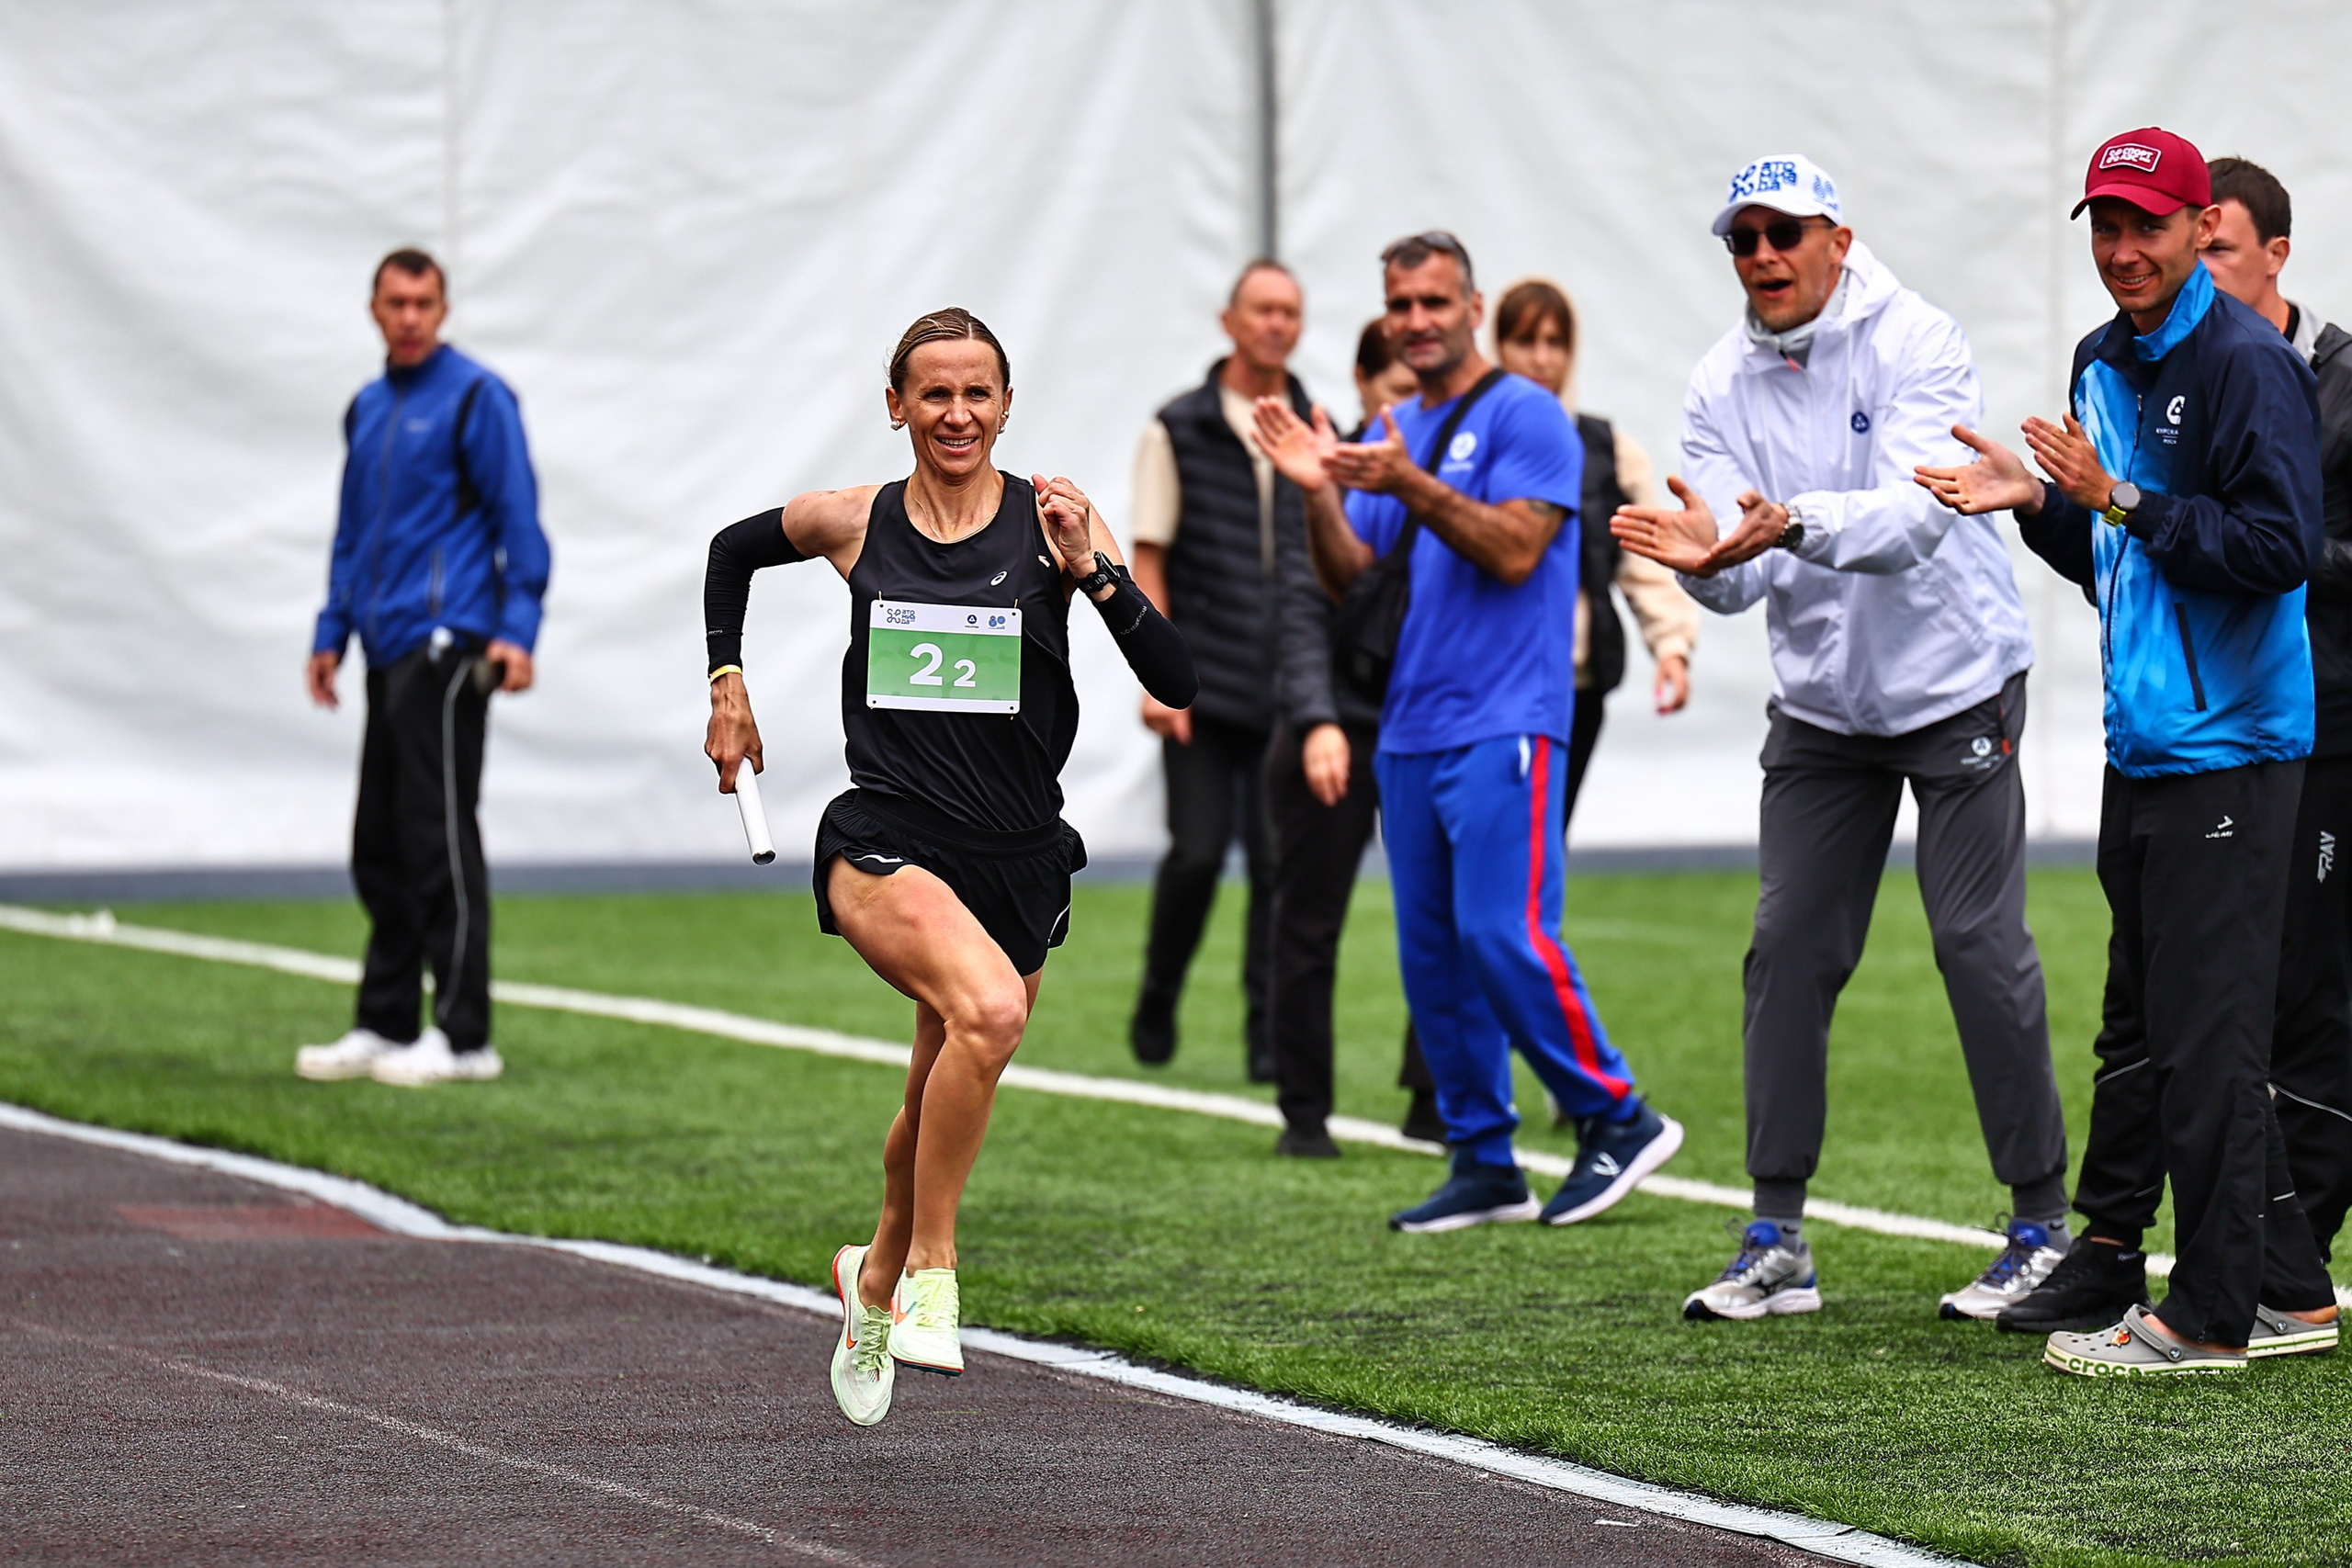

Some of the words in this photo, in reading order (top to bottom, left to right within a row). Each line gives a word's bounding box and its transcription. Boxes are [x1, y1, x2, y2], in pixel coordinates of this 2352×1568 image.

[910, 642, 943, 686] 2
[954, 659, 976, 688] 2
[2069, 1358, 2142, 1379] crocs
